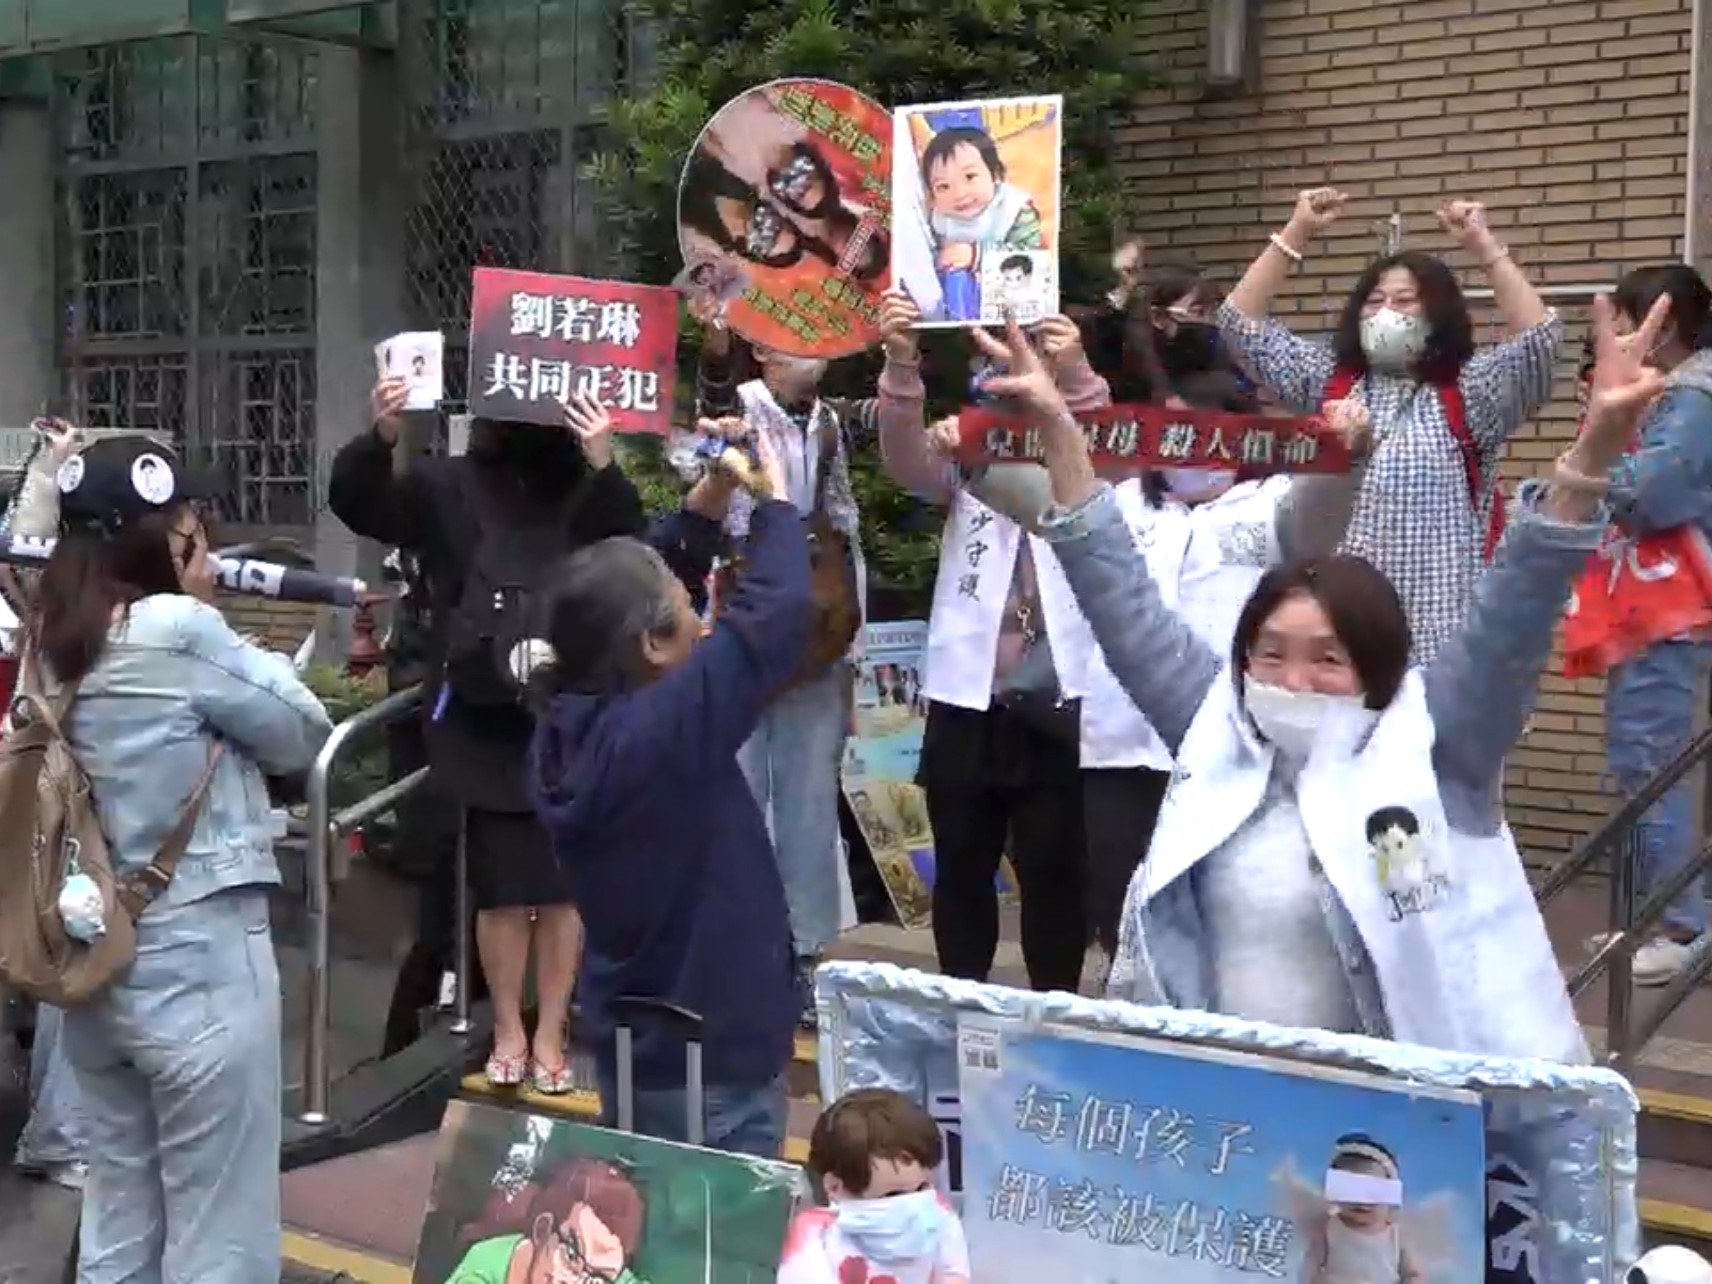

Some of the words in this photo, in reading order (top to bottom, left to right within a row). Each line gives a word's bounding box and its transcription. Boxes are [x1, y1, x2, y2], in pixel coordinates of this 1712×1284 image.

[510, 291, 641, 347] 劉若琳
[483, 351, 659, 412] 共同正犯
[1015, 1084, 1257, 1176] 每個孩子
[986, 1164, 1294, 1279] 都該被保護
